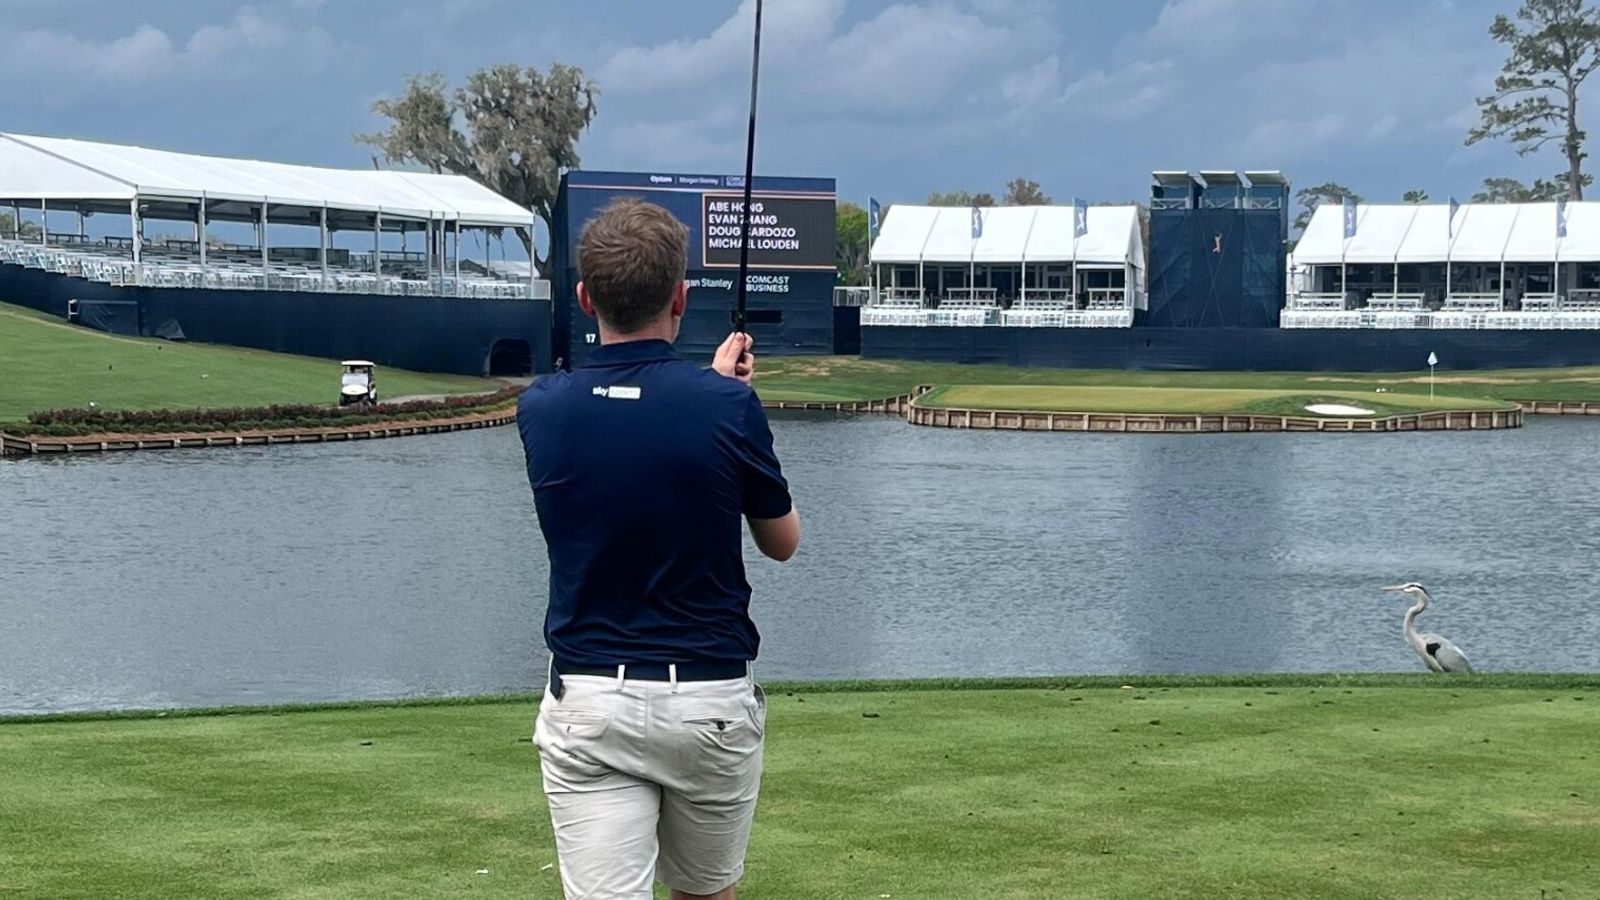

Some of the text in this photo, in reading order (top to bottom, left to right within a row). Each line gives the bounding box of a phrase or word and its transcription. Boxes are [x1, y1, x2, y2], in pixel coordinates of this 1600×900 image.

[708, 202, 729, 212] ABE
[708, 214, 738, 224] EVAN
[708, 226, 741, 236] DOUG
[757, 239, 799, 249] LOUDEN
[701, 278, 733, 290] Stanley
[745, 276, 789, 284] COMCAST
[745, 284, 789, 292] BUSINESS
[585, 333, 596, 343] 17
